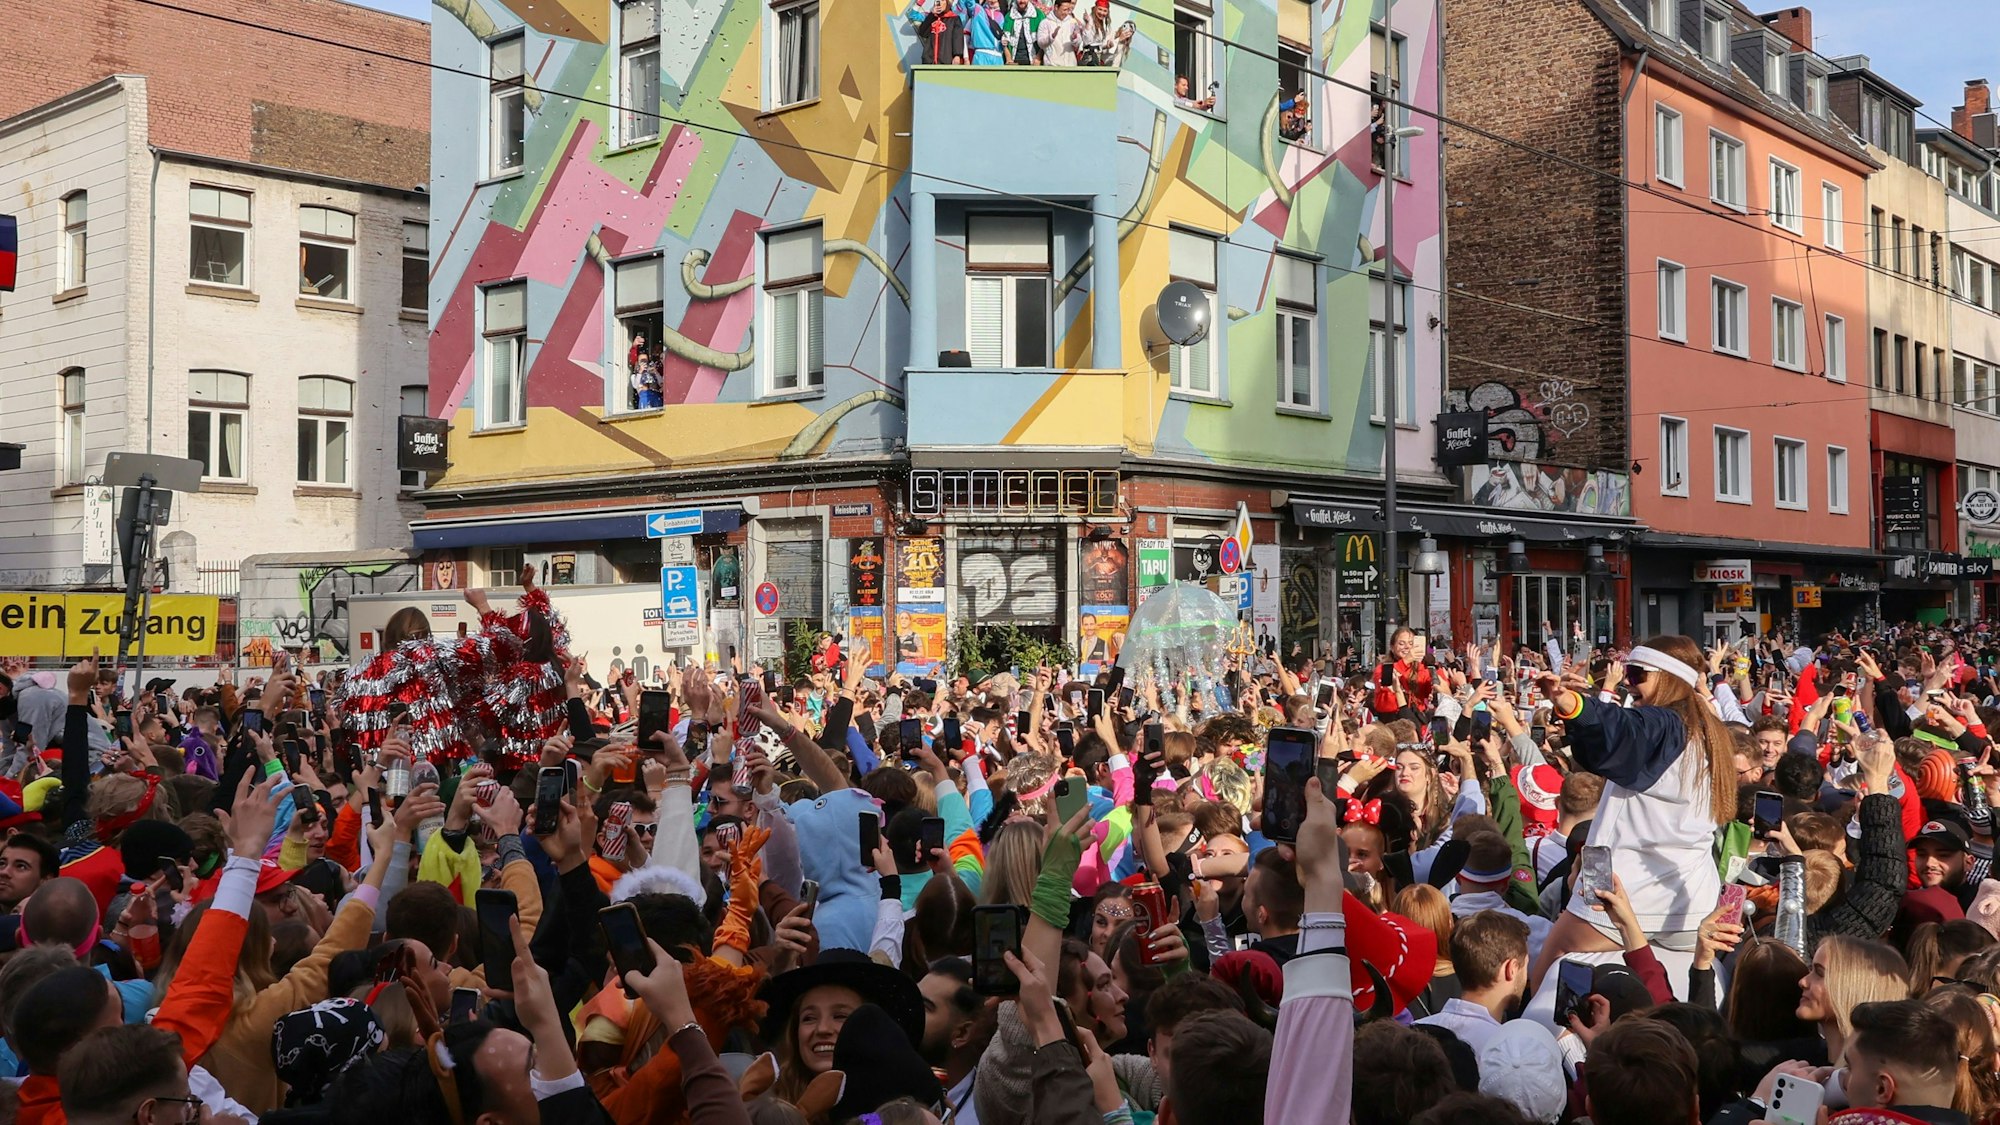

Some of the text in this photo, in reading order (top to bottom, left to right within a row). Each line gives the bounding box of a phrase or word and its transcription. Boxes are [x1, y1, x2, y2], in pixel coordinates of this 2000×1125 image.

[413, 432, 439, 445] Gaffel
[1446, 427, 1472, 439] Gaffel
[916, 475, 1116, 509] STIEFEL
[663, 517, 699, 527] Einbahnstraße
[1310, 508, 1332, 524] Gaffel
[1140, 541, 1156, 549] READY
[1141, 559, 1167, 575] TABU
[1966, 562, 1989, 575] sky
[667, 570, 683, 591] P
[1710, 569, 1745, 579] KIOSK
[644, 609, 658, 618] TOI
